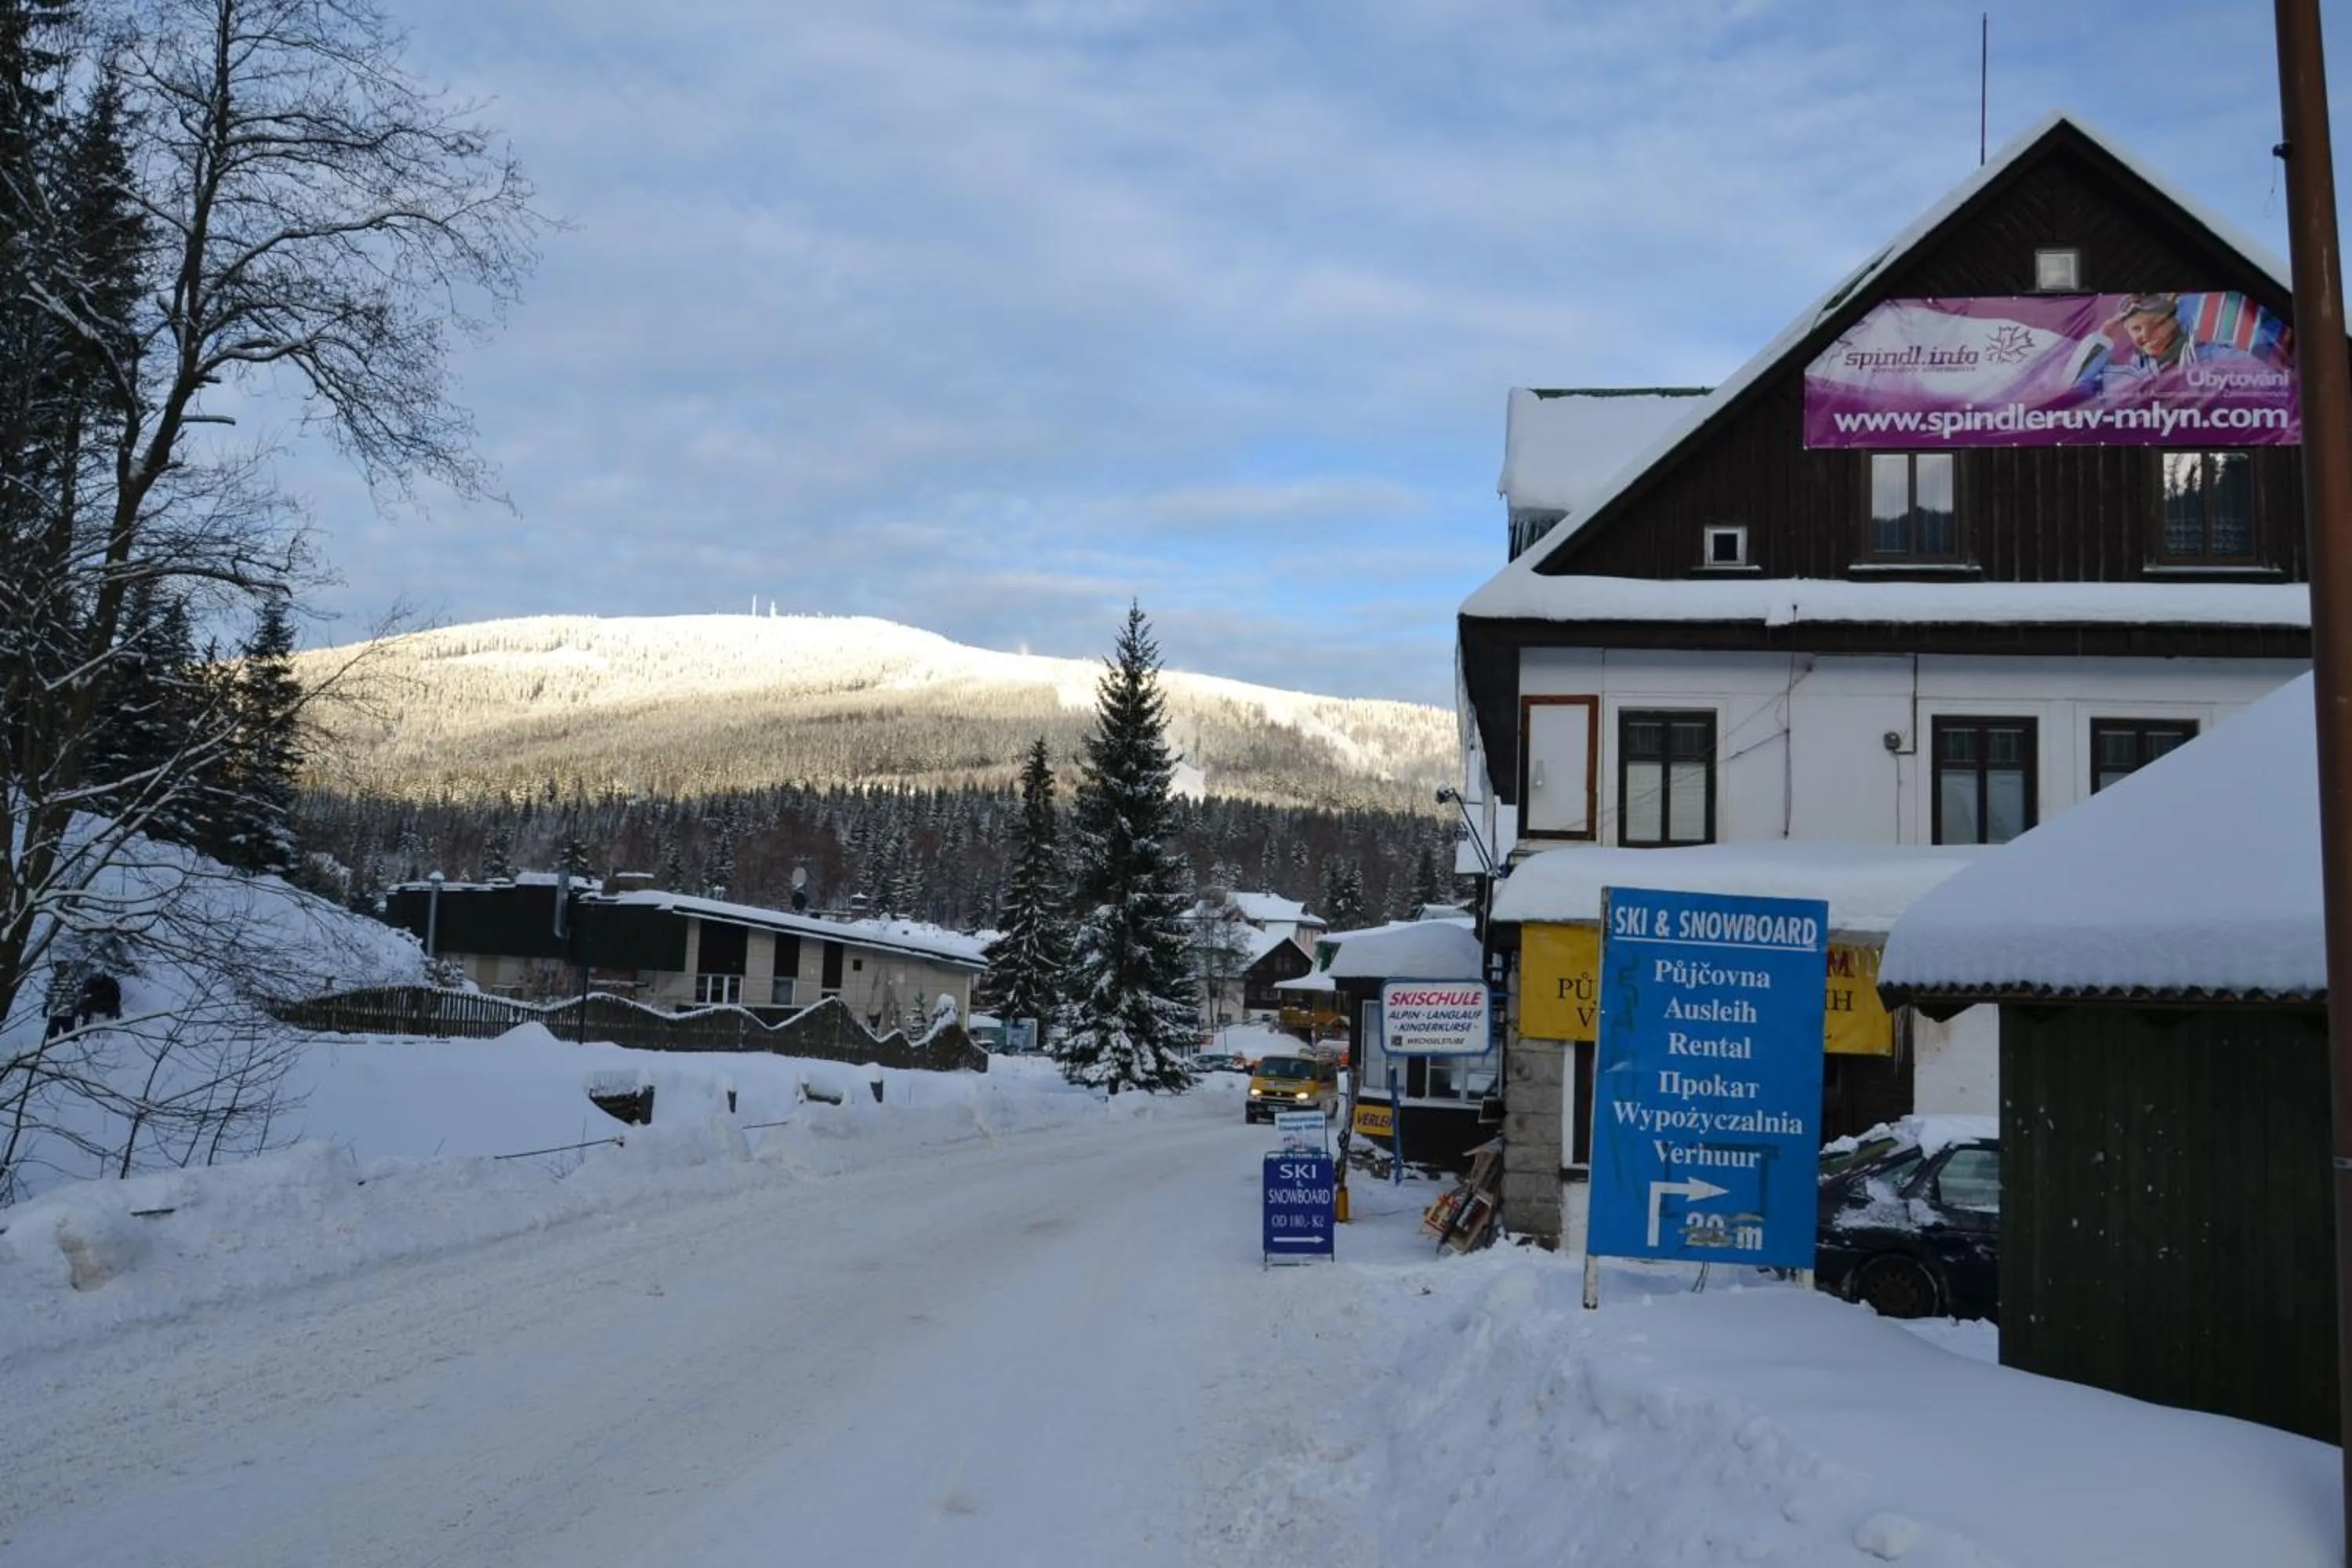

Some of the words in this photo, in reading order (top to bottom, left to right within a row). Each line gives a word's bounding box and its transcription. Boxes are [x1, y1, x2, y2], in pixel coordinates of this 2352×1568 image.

[1843, 343, 1979, 371] spindl.info
[1834, 401, 2288, 437] www.spindleruv-mlyn.com
[1615, 906, 1647, 935] SKI
[1654, 909, 1670, 937] &
[1679, 910, 1817, 946] SNOWBOARD
[1654, 959, 1770, 989] Půjčovna
[1388, 992, 1482, 1006] SKISCHULE
[1663, 996, 1757, 1024] Ausleih
[1388, 1010, 1419, 1020] ALPIN
[1427, 1010, 1483, 1020] LANGLAUF
[1399, 1022, 1472, 1033] KINDERKURSE
[1668, 1032, 1751, 1059] Rental
[1658, 1071, 1759, 1099] Прокат
[1613, 1101, 1803, 1134] Wypożyczalnia
[1653, 1139, 1761, 1167] Verhuur
[1279, 1164, 1316, 1179] SKI
[1269, 1189, 1330, 1204] SNOWBOARD
